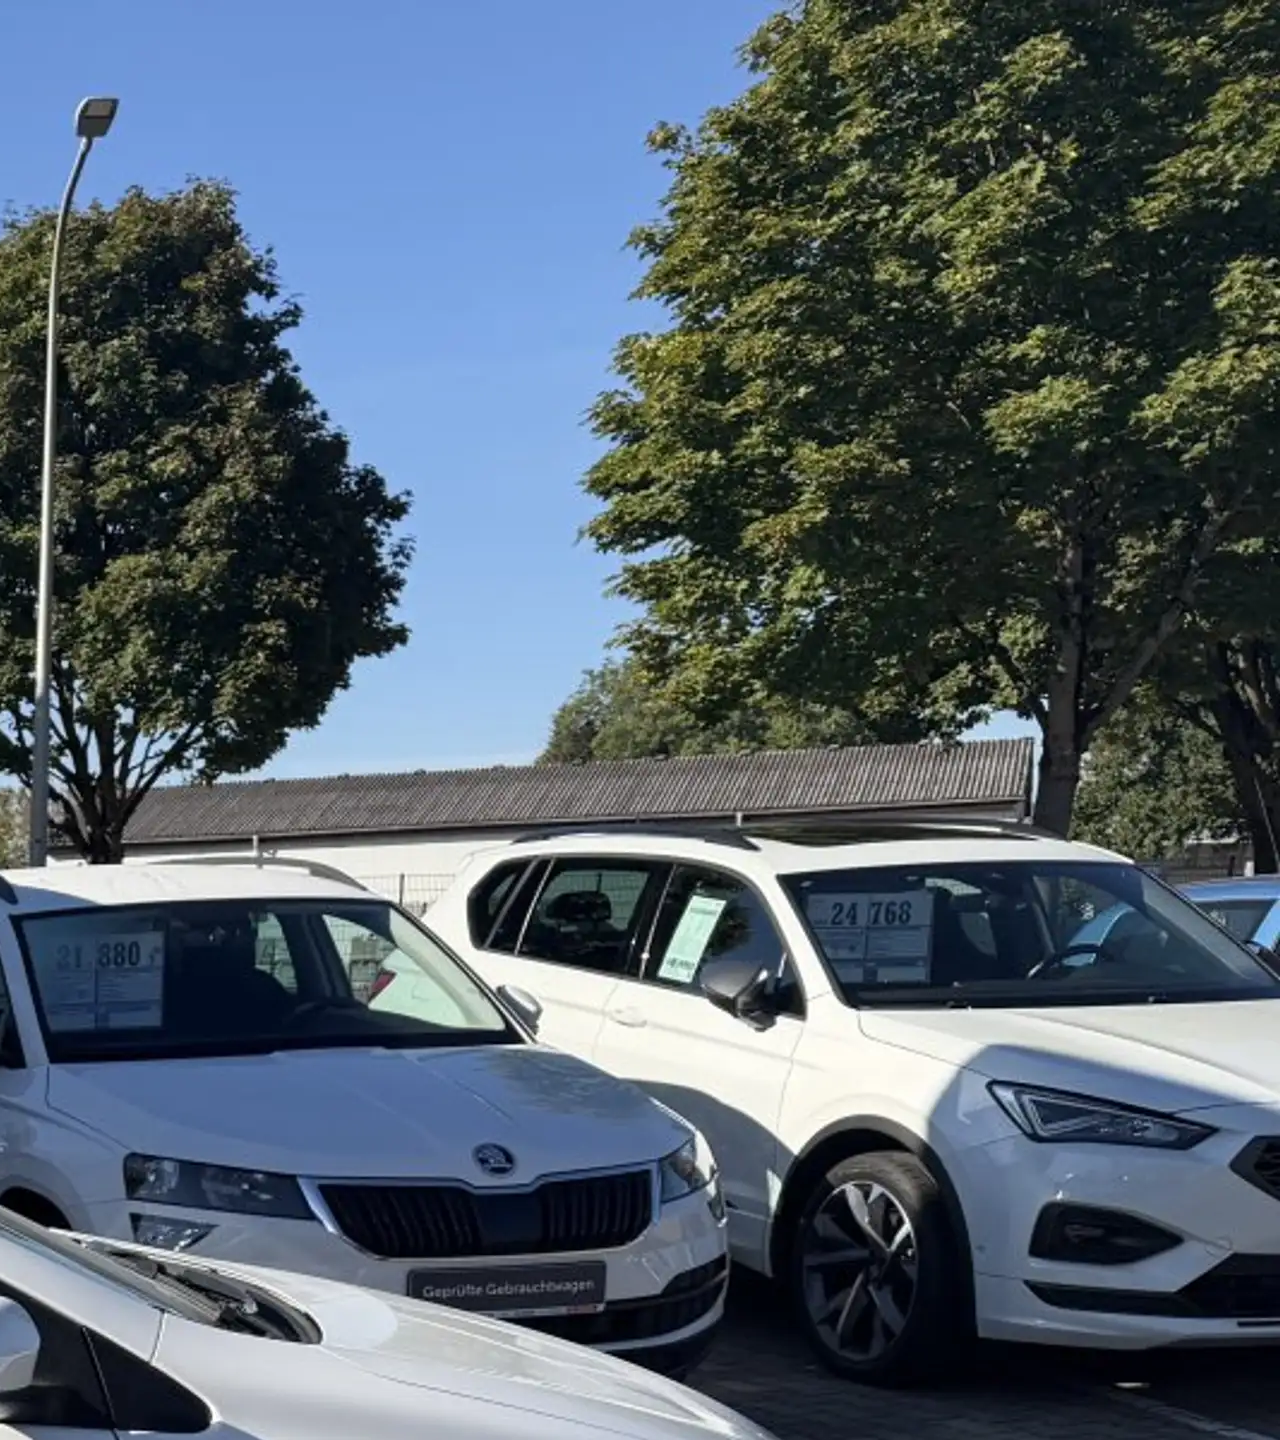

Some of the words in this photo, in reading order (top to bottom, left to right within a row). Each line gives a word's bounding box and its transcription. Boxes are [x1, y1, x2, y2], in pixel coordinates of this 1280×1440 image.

[831, 901, 858, 926] 24
[870, 900, 912, 926] 768
[422, 1282, 482, 1298] Geprüfte
[486, 1278, 595, 1296] Gebrauchtwagen
